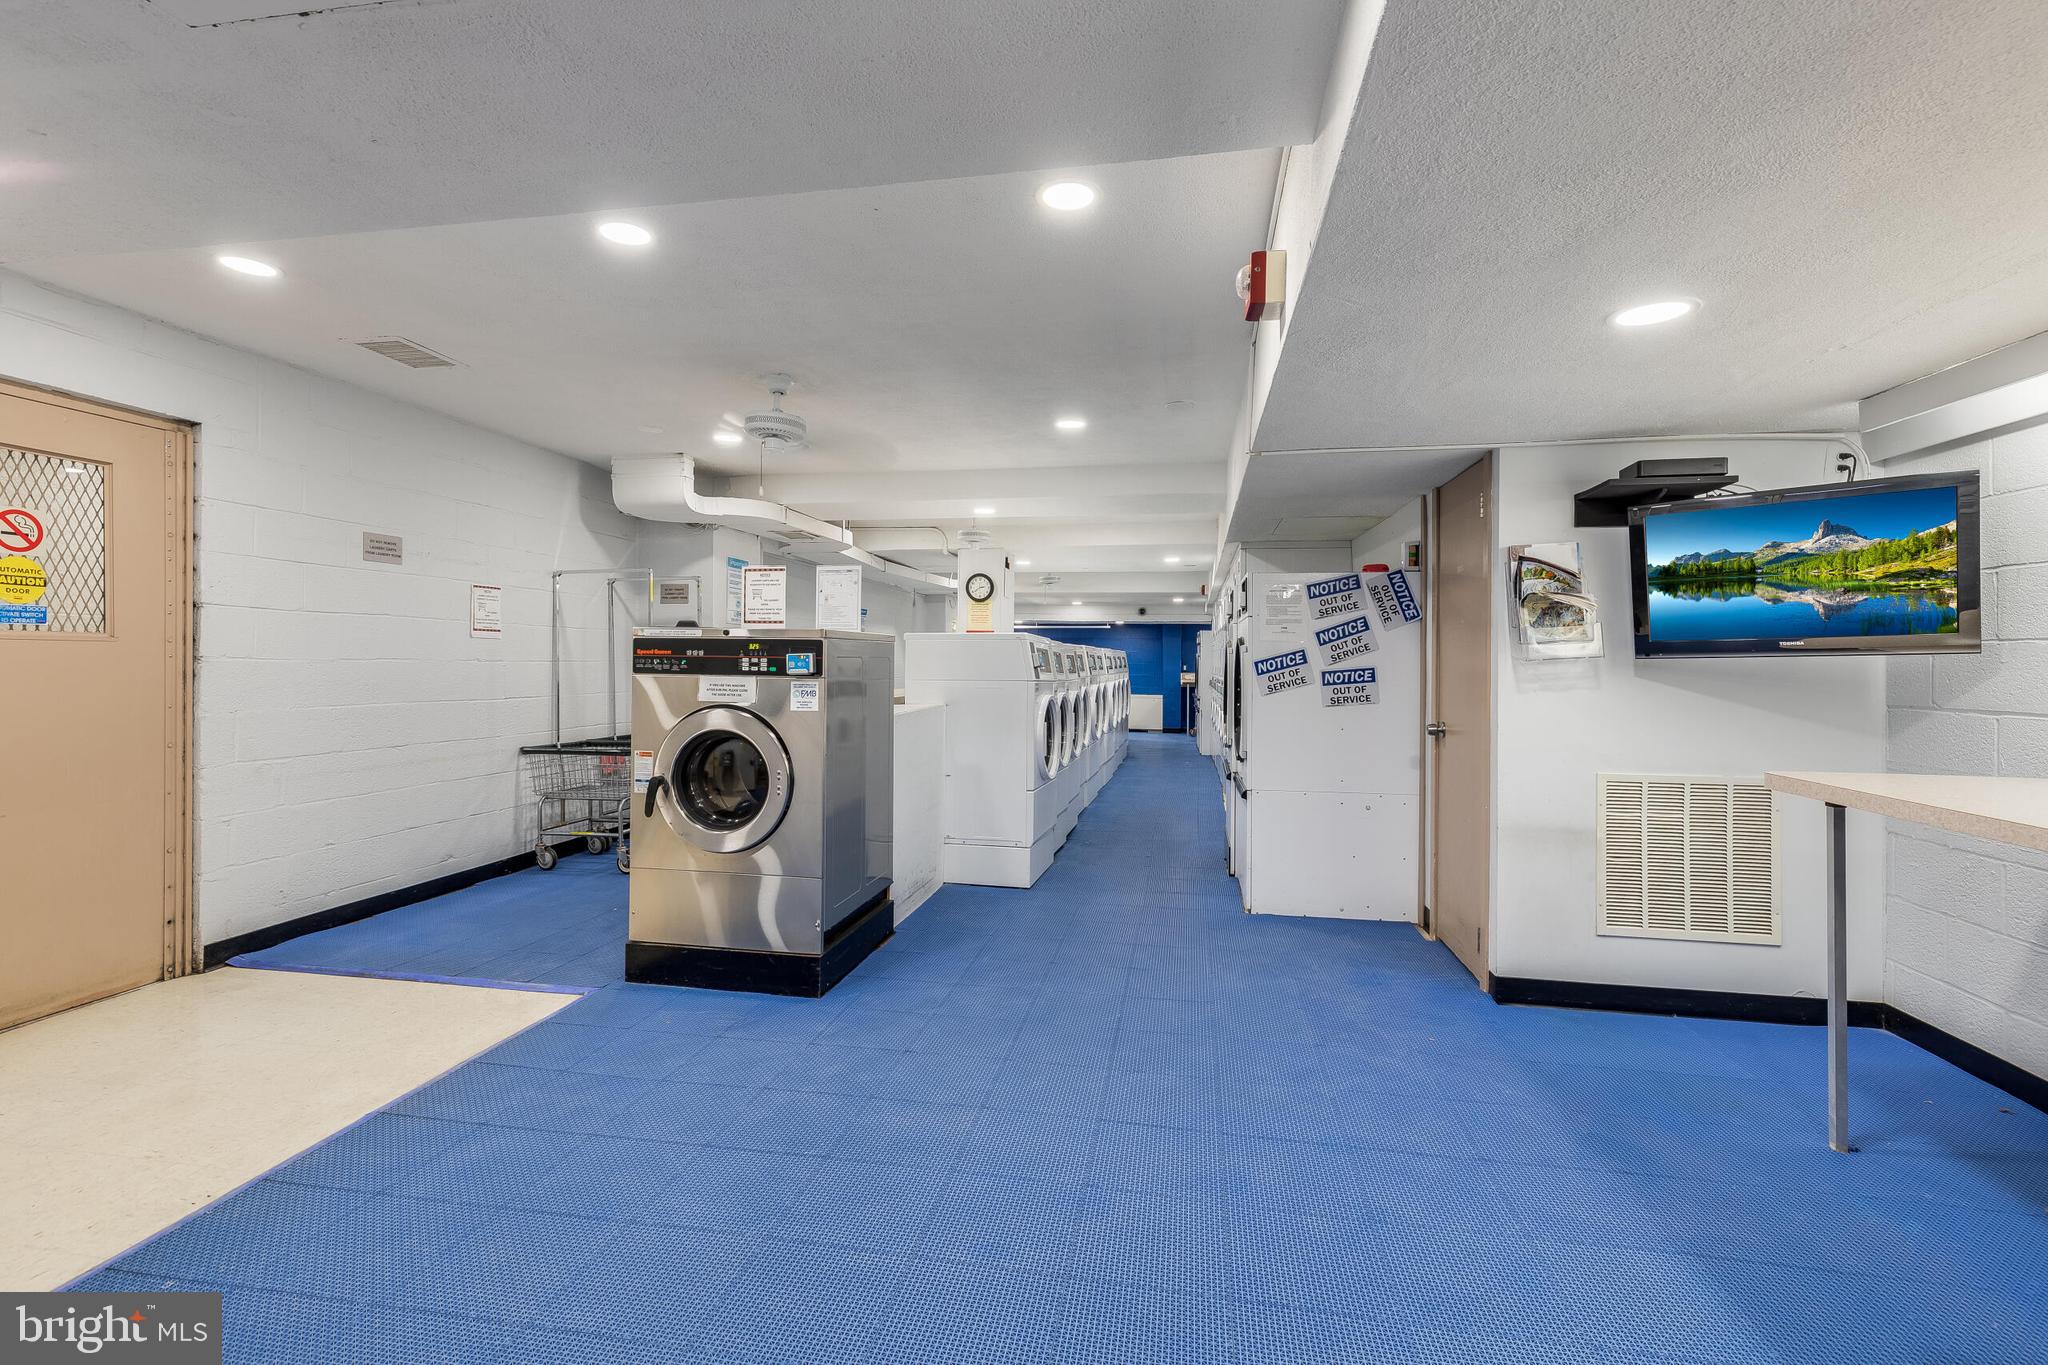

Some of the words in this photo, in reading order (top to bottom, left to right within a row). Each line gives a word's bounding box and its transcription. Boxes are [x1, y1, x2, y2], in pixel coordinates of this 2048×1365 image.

[0, 567, 42, 575] UTOMATIC
[0, 575, 45, 586] AUTION
[1310, 576, 1358, 597] NOTICE
[1320, 596, 1338, 606] OUT
[1341, 593, 1353, 602] OF
[1381, 585, 1394, 602] OUT
[1389, 604, 1400, 616] OF
[1390, 573, 1417, 618] NOTICE
[1318, 601, 1359, 616] SERVICE
[1371, 585, 1392, 624] SERVICE
[1319, 619, 1366, 644] NOTICE
[1330, 640, 1348, 652] OUT
[1351, 635, 1363, 645] OF
[1330, 642, 1371, 662] SERVICE
[1257, 652, 1304, 673] NOTICE
[1267, 671, 1286, 682] OUT
[1288, 668, 1301, 677] OF
[1324, 670, 1373, 684] NOTICE
[1267, 676, 1307, 692] SERVICE
[1332, 686, 1351, 695] OUT
[1354, 685, 1367, 693] OF
[1330, 694, 1372, 704] SERVICE
